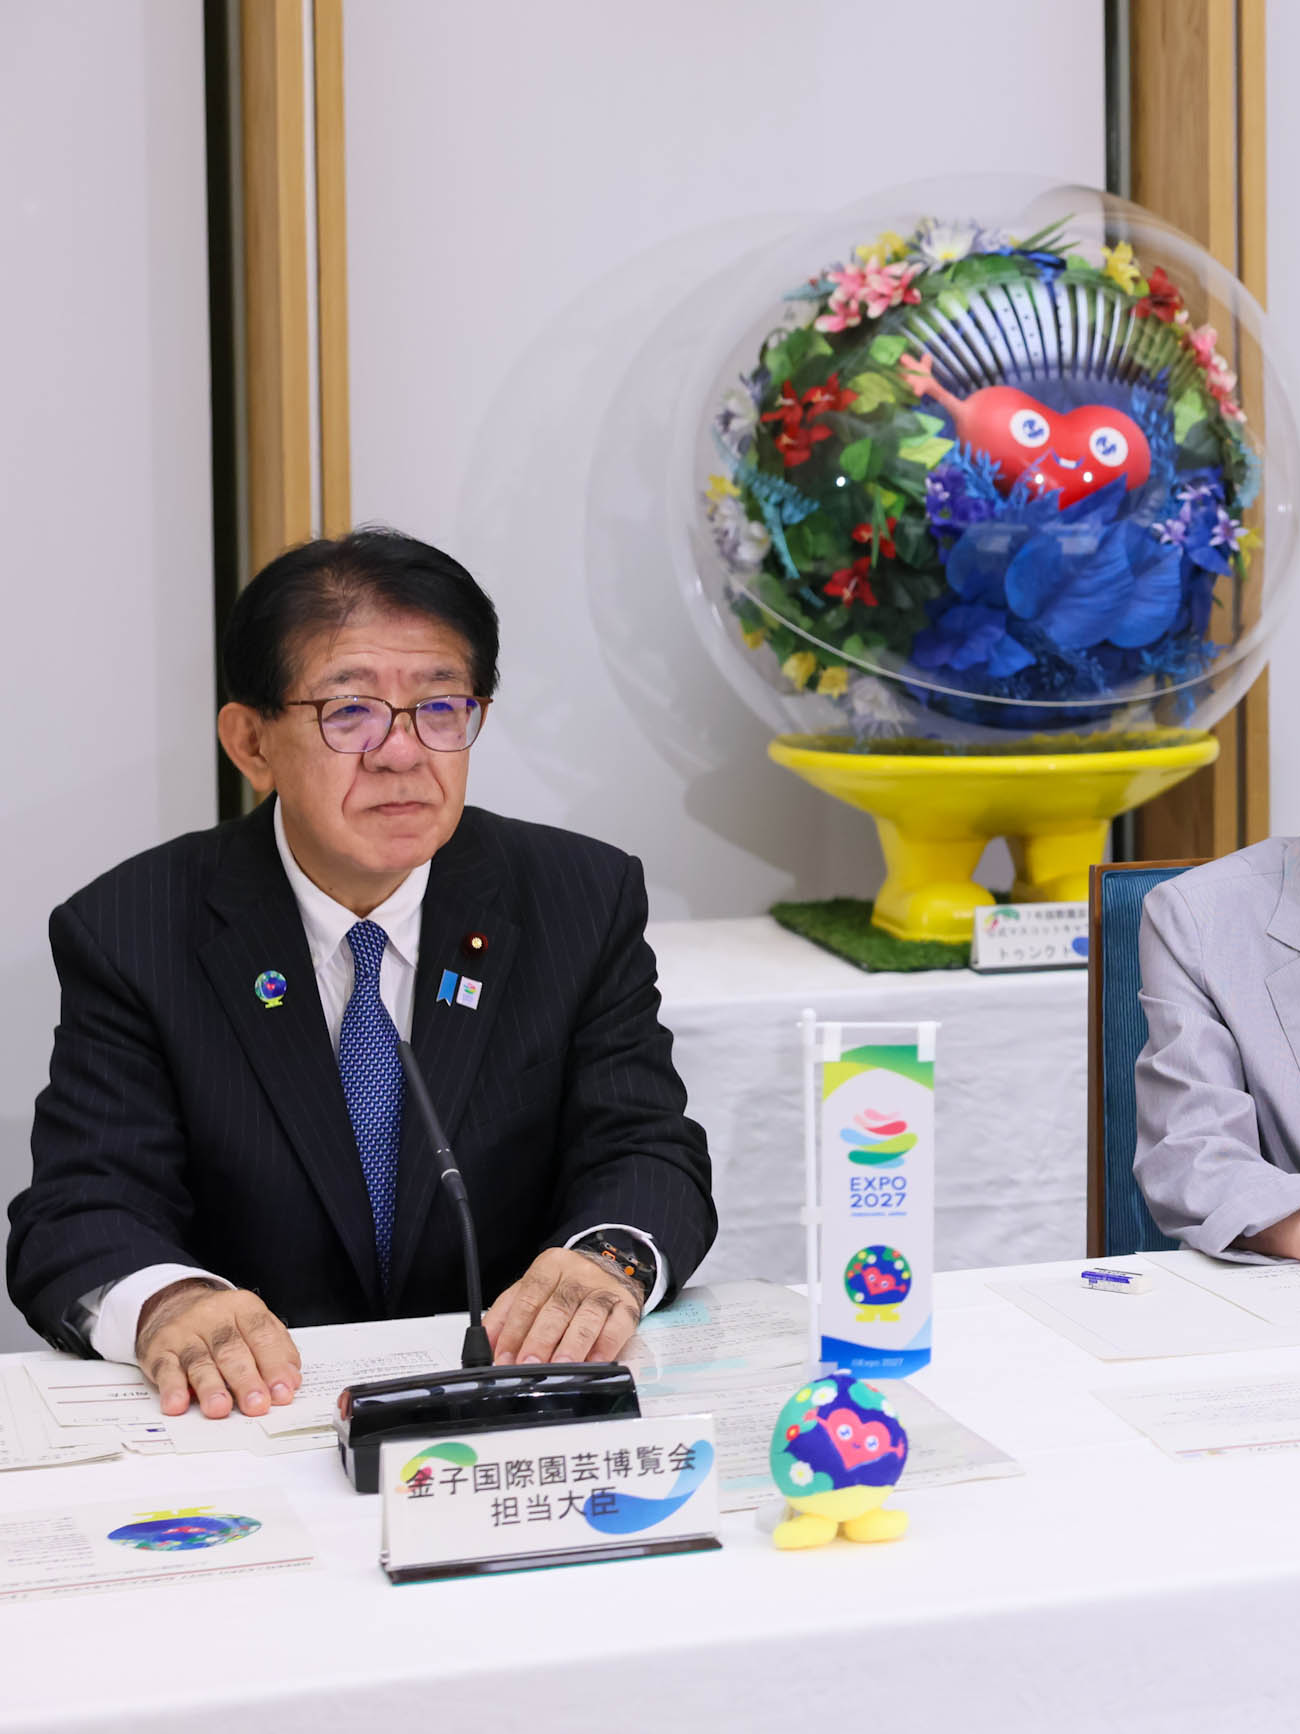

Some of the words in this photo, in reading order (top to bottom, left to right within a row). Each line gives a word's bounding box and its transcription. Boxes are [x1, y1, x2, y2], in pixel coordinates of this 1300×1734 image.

[850, 1176, 907, 1192] EXPO
[850, 1192, 907, 1208] 2027
[406, 1441, 697, 1499] 金子国際園芸博覧会
[491, 1486, 620, 1527] 担当大臣
